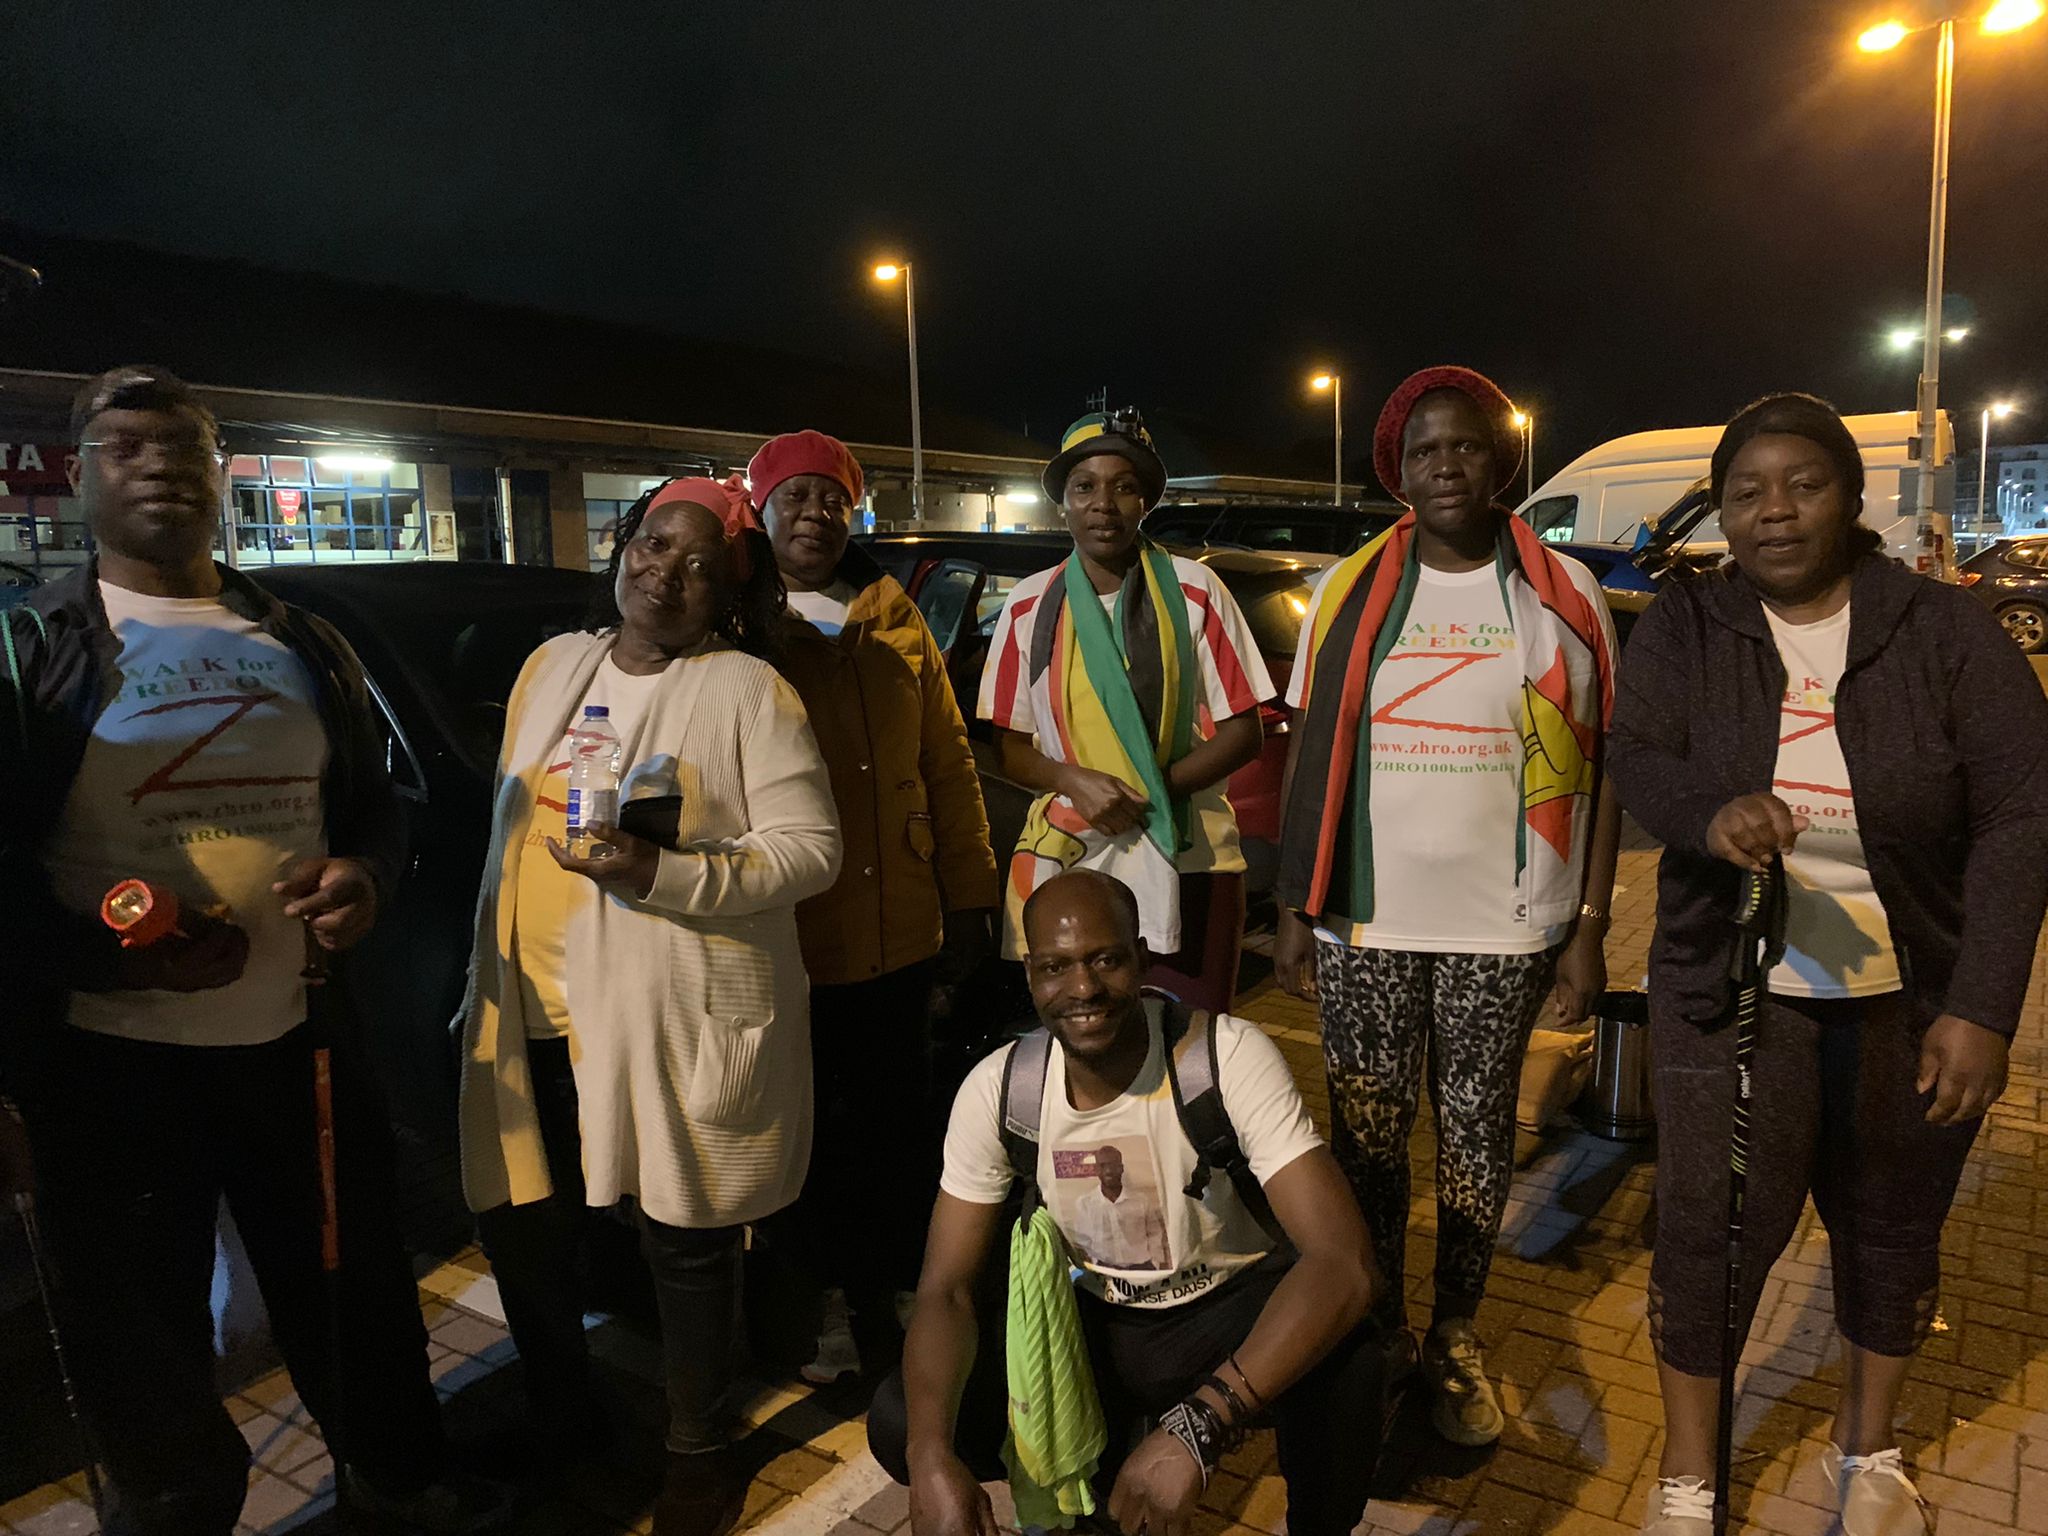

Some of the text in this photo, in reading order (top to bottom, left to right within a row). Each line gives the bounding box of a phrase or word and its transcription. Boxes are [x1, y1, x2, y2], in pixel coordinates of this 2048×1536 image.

[1479, 623, 1515, 634] for
[236, 657, 278, 672] for
[526, 829, 563, 846] zho
[1172, 1272, 1214, 1299] DAISY
